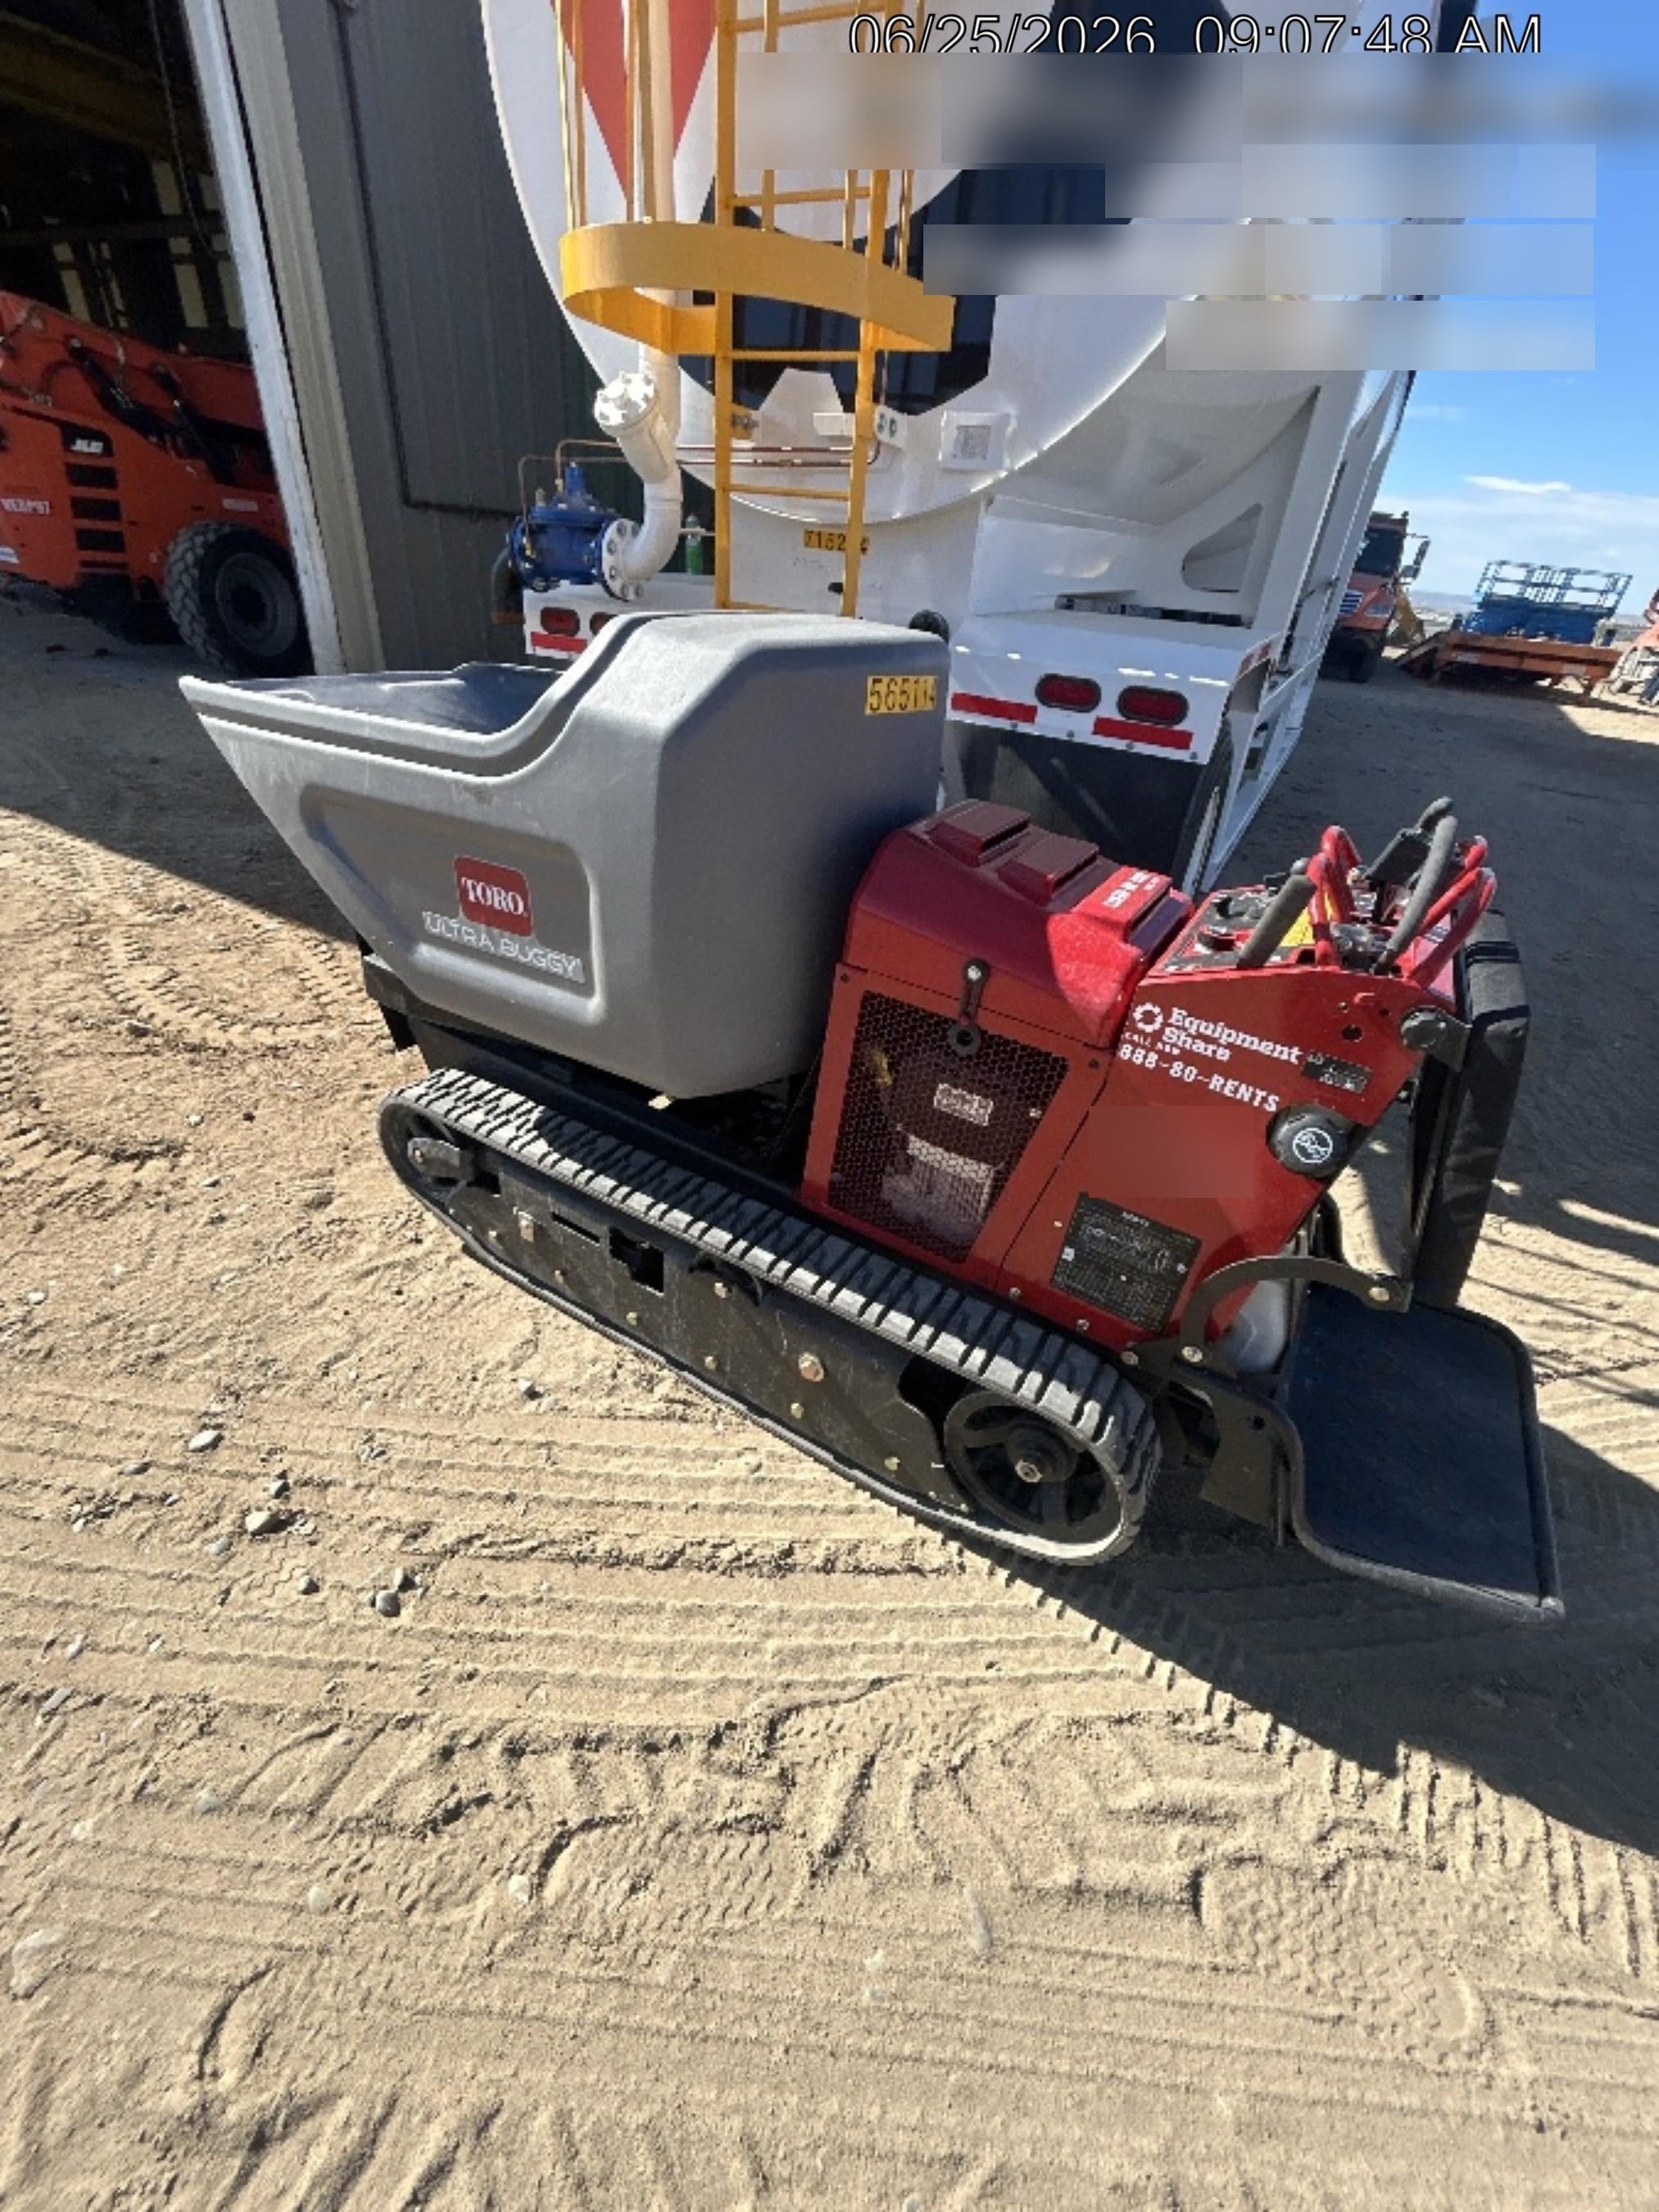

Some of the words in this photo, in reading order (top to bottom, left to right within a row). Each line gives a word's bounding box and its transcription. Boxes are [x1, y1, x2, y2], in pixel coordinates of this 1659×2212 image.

[805, 530, 869, 555] 71524
[461, 877, 525, 915] TORO
[423, 911, 494, 952] ULTRA
[500, 937, 582, 979] BUGGY
[1162, 1026, 1231, 1062] Share
[1167, 1006, 1303, 1064] Equipment
